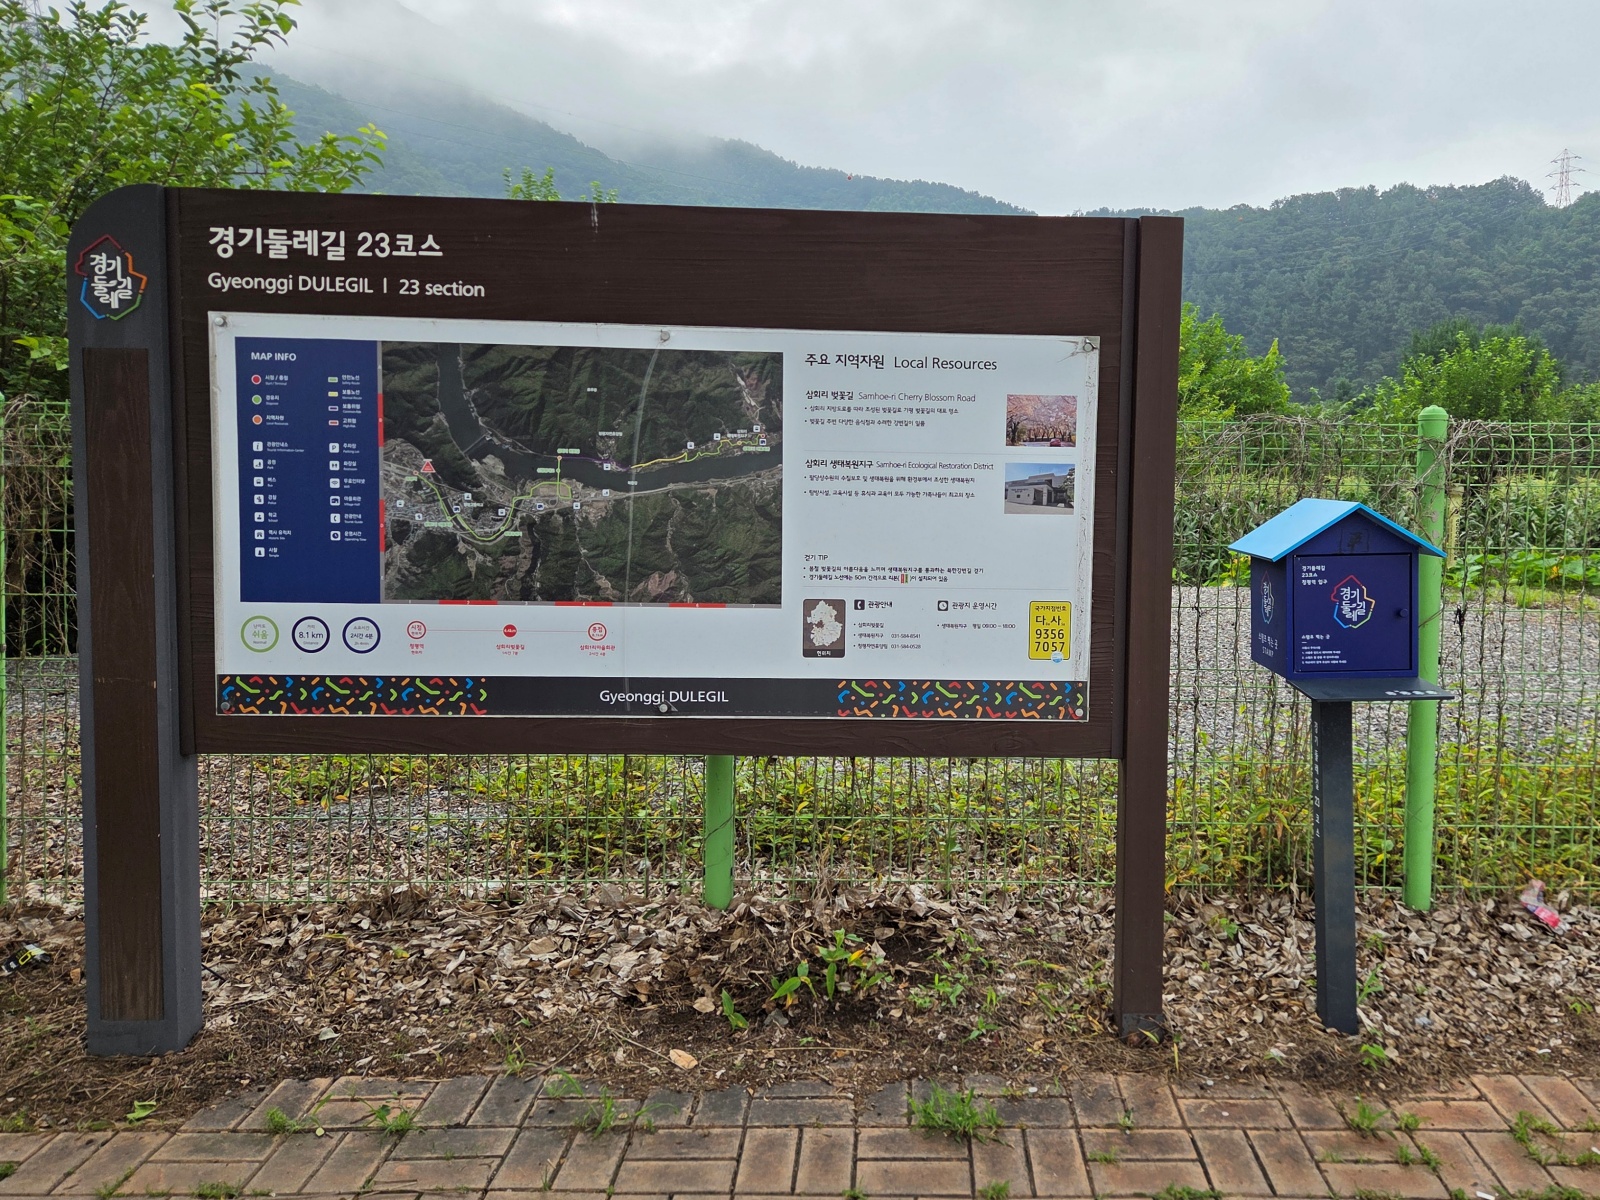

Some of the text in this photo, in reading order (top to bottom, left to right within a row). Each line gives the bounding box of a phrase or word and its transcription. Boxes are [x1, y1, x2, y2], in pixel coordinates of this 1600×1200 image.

[208, 226, 443, 261] 경기둘레길 23코스
[208, 272, 485, 297] Gyeonggi DULEGIL 23 section
[251, 352, 296, 361] MAP INFO
[804, 353, 884, 370] 주요 지역자원
[894, 356, 997, 370] Local Resources
[806, 390, 854, 400] 삼회리 벚꽃길
[859, 392, 976, 402] Samhoe-ri Cherry Blossom Road
[805, 459, 873, 469] 삼회리 생태복원지구
[908, 462, 937, 470] Ecological
[252, 630, 268, 640] 쉬움
[1036, 629, 1064, 640] 9356
[1035, 641, 1065, 652] 7057
[600, 690, 729, 705] Gyeonggi DULEGIL
